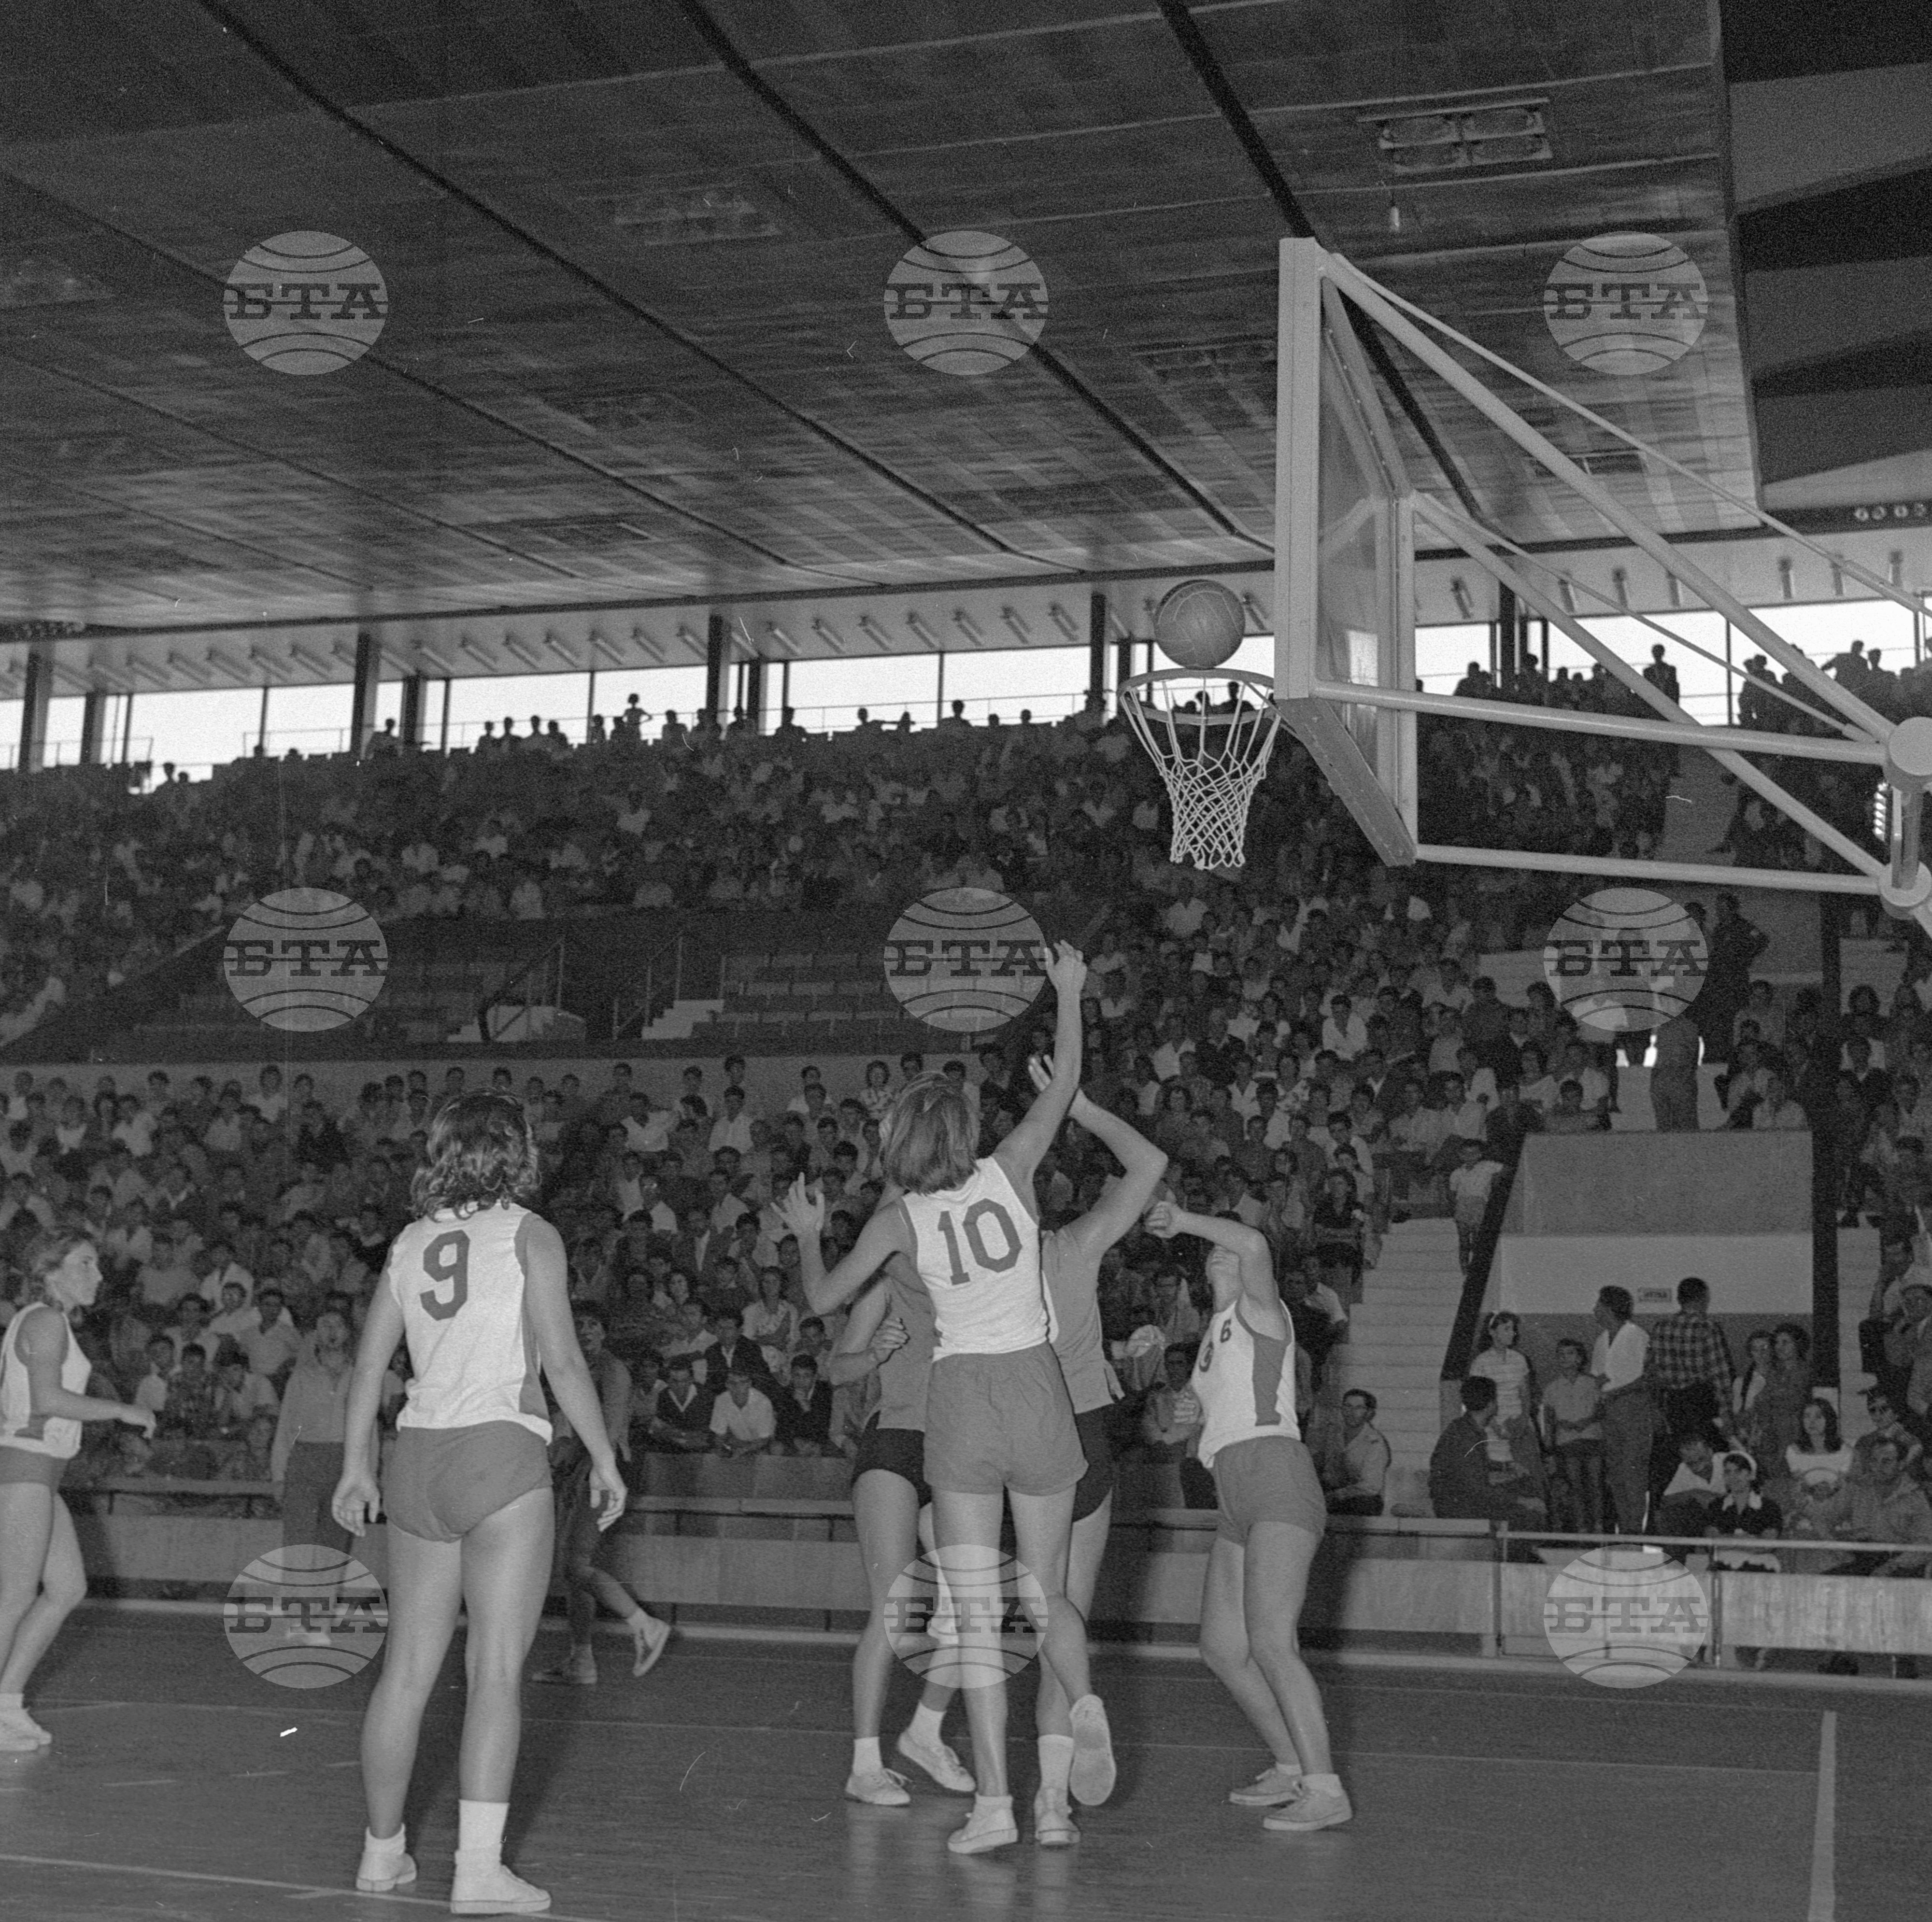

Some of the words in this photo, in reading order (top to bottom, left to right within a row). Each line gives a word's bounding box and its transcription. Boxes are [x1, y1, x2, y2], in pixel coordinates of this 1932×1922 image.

[419, 1229, 470, 1321] 9
[937, 1198, 1023, 1286] 10
[1220, 1318, 1232, 1343] 6
